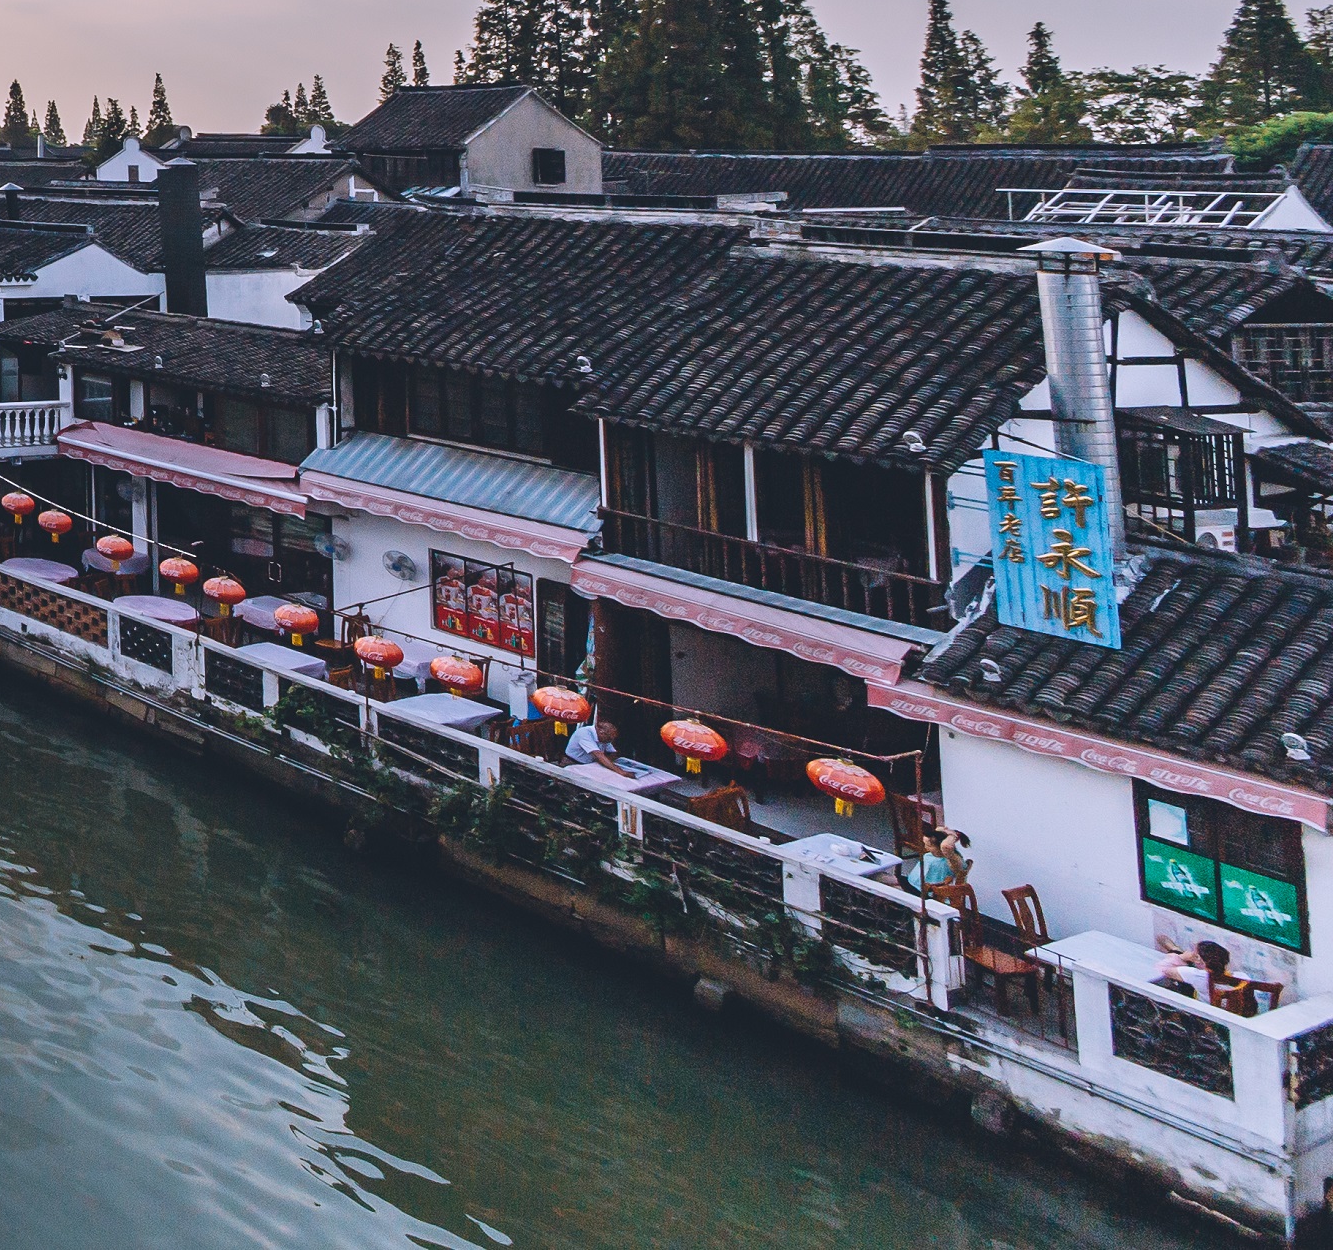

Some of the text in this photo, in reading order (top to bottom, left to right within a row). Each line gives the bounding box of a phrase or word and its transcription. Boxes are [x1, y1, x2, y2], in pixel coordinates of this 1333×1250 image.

[992, 460, 1025, 563] 百年老店
[1030, 476, 1103, 639] 許永順
